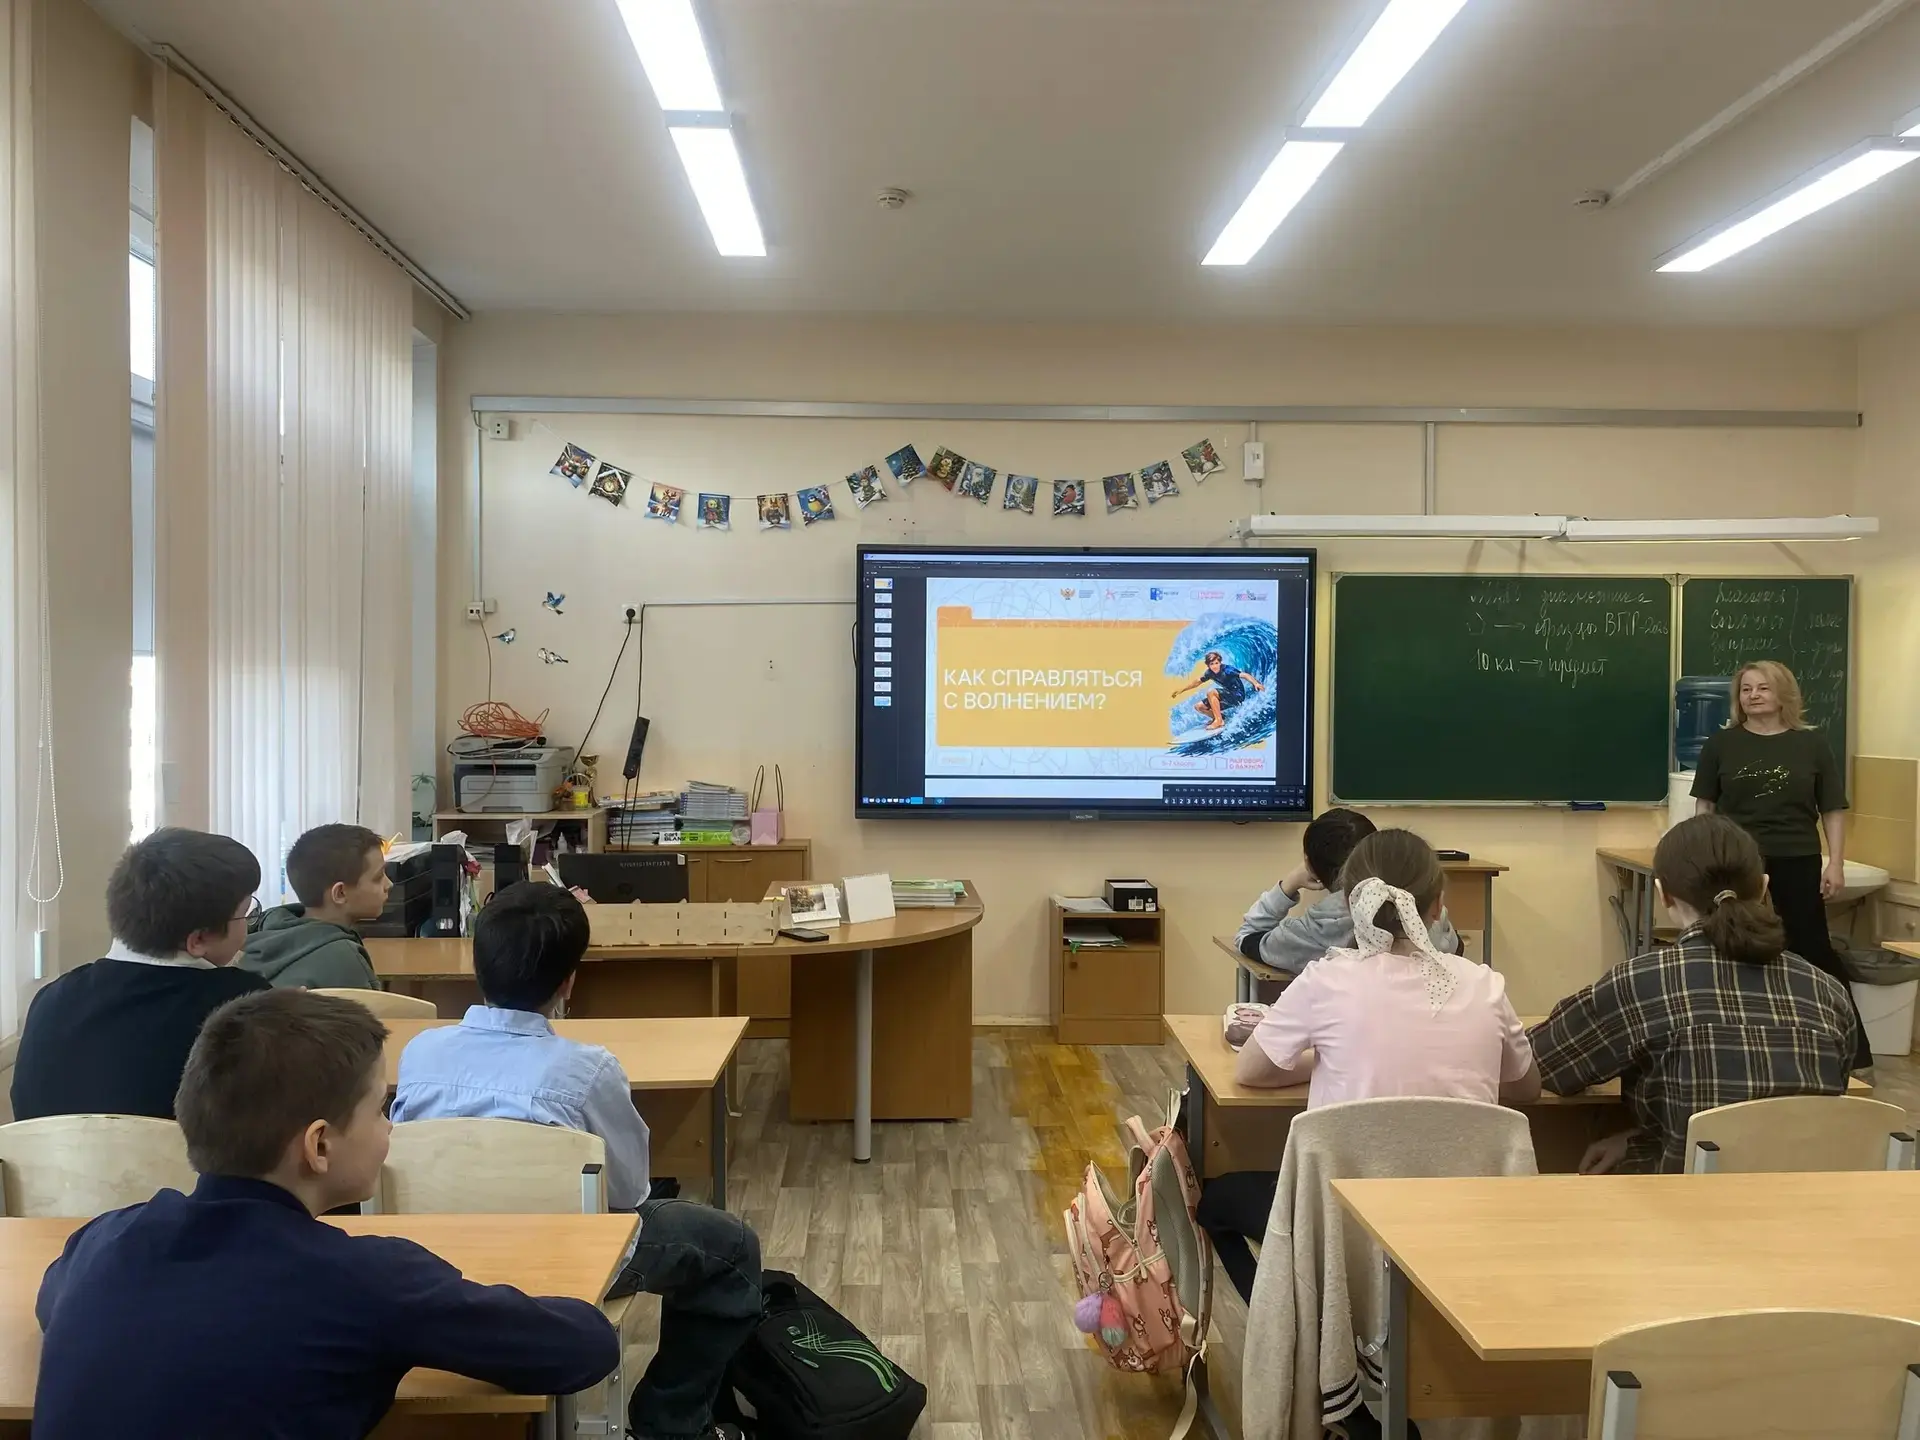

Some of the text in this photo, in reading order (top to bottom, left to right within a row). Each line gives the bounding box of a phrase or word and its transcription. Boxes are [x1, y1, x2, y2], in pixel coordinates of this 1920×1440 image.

[1473, 648, 1490, 671] 10
[943, 668, 1143, 688] КАК СПРАВЛЯТЬСЯ
[943, 691, 1107, 711] С ВОЛНЕНИЕМ?
